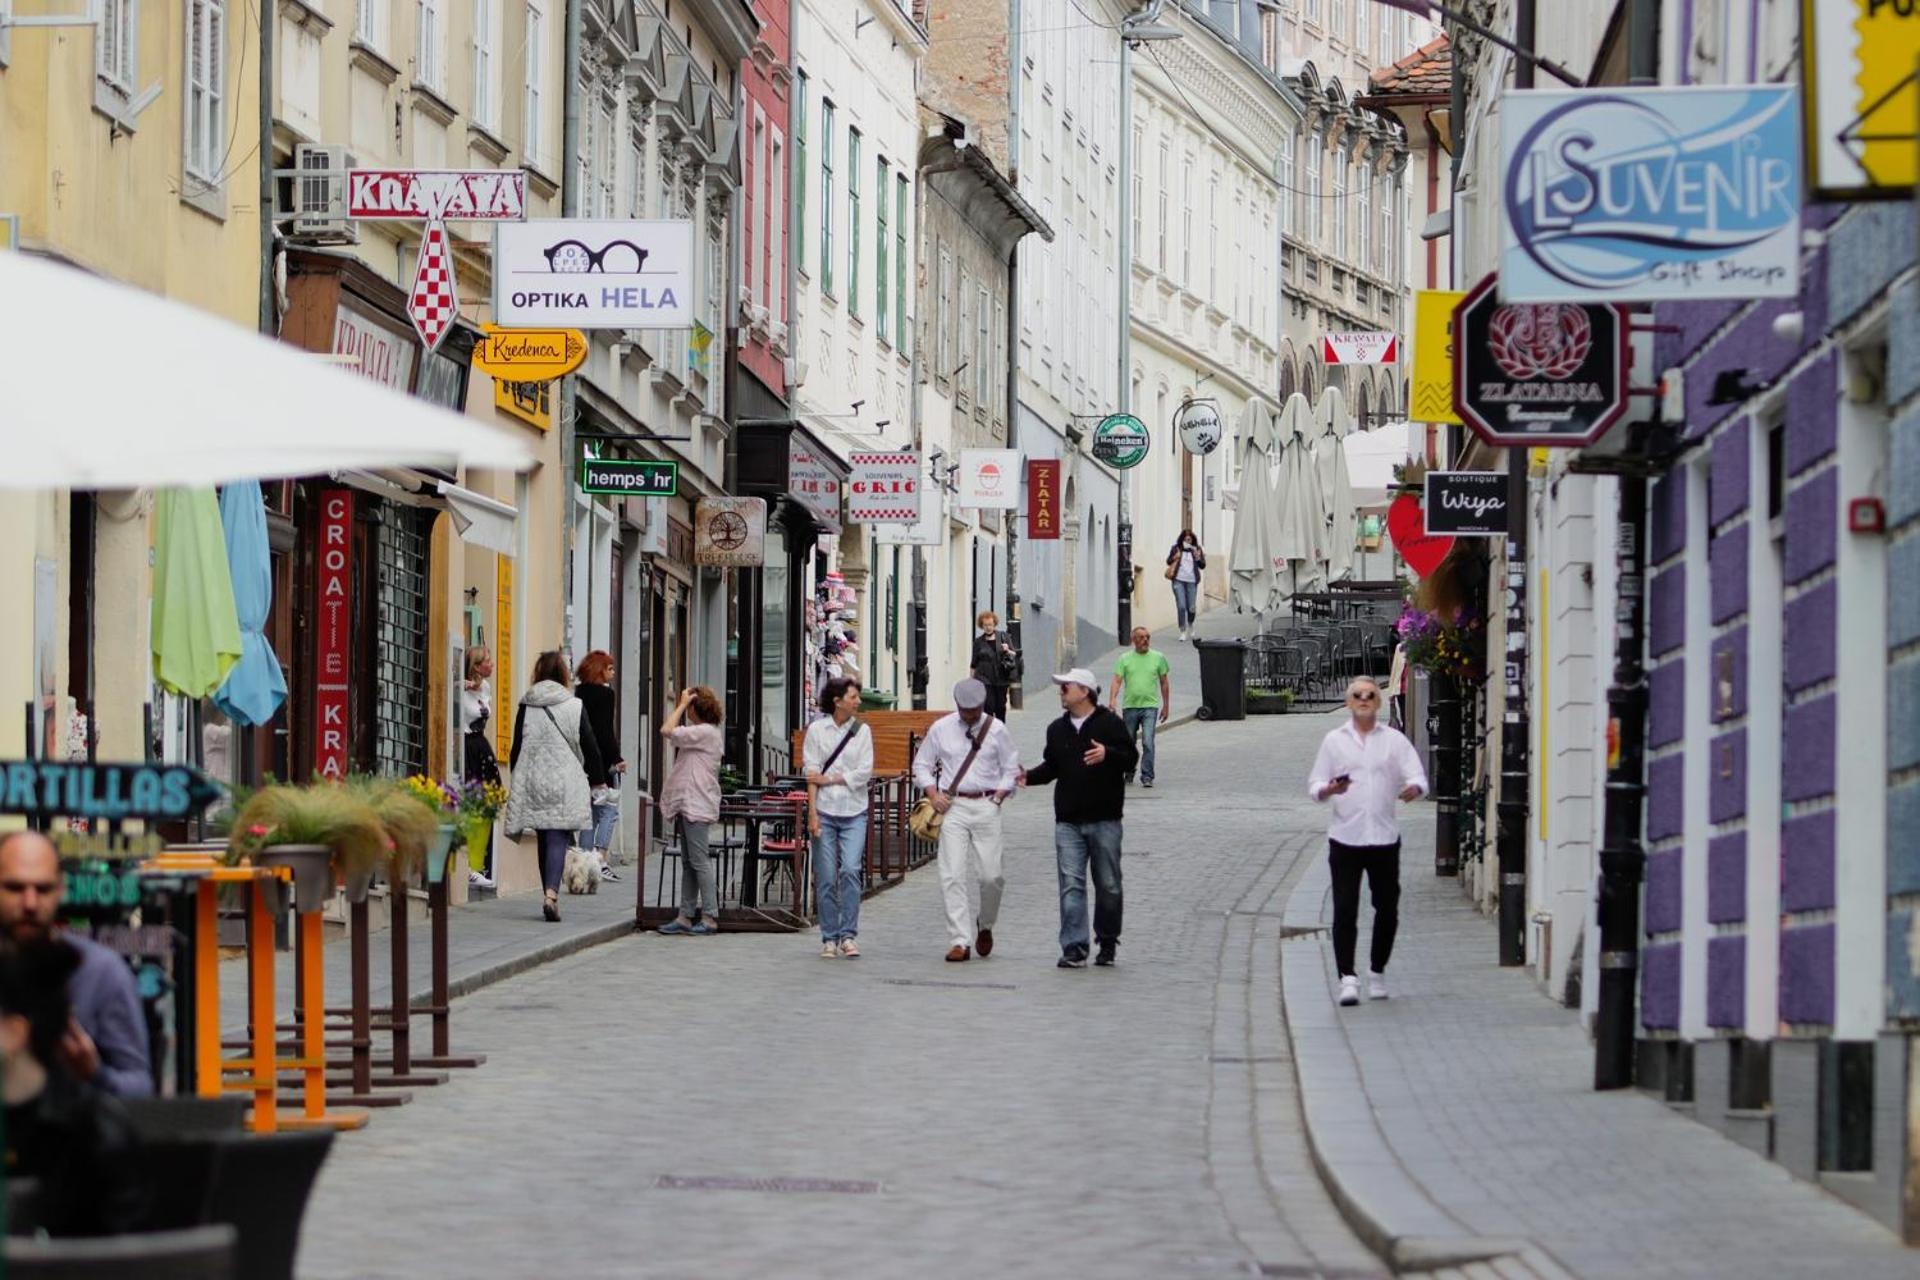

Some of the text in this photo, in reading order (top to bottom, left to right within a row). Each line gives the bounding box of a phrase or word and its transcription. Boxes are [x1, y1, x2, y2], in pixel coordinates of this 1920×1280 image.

[1650, 259, 1787, 287] Gift Shop
[511, 287, 679, 309] OPTIKA HELA
[493, 335, 560, 362] Kredenca
[1479, 382, 1604, 401] ZLATARNA
[588, 469, 672, 490] hemps hr
[851, 476, 917, 494] GRIČ
[1448, 475, 1498, 484] BOUTIQUE
[1037, 468, 1051, 528] ZLATAR
[1440, 489, 1506, 518] Wiya
